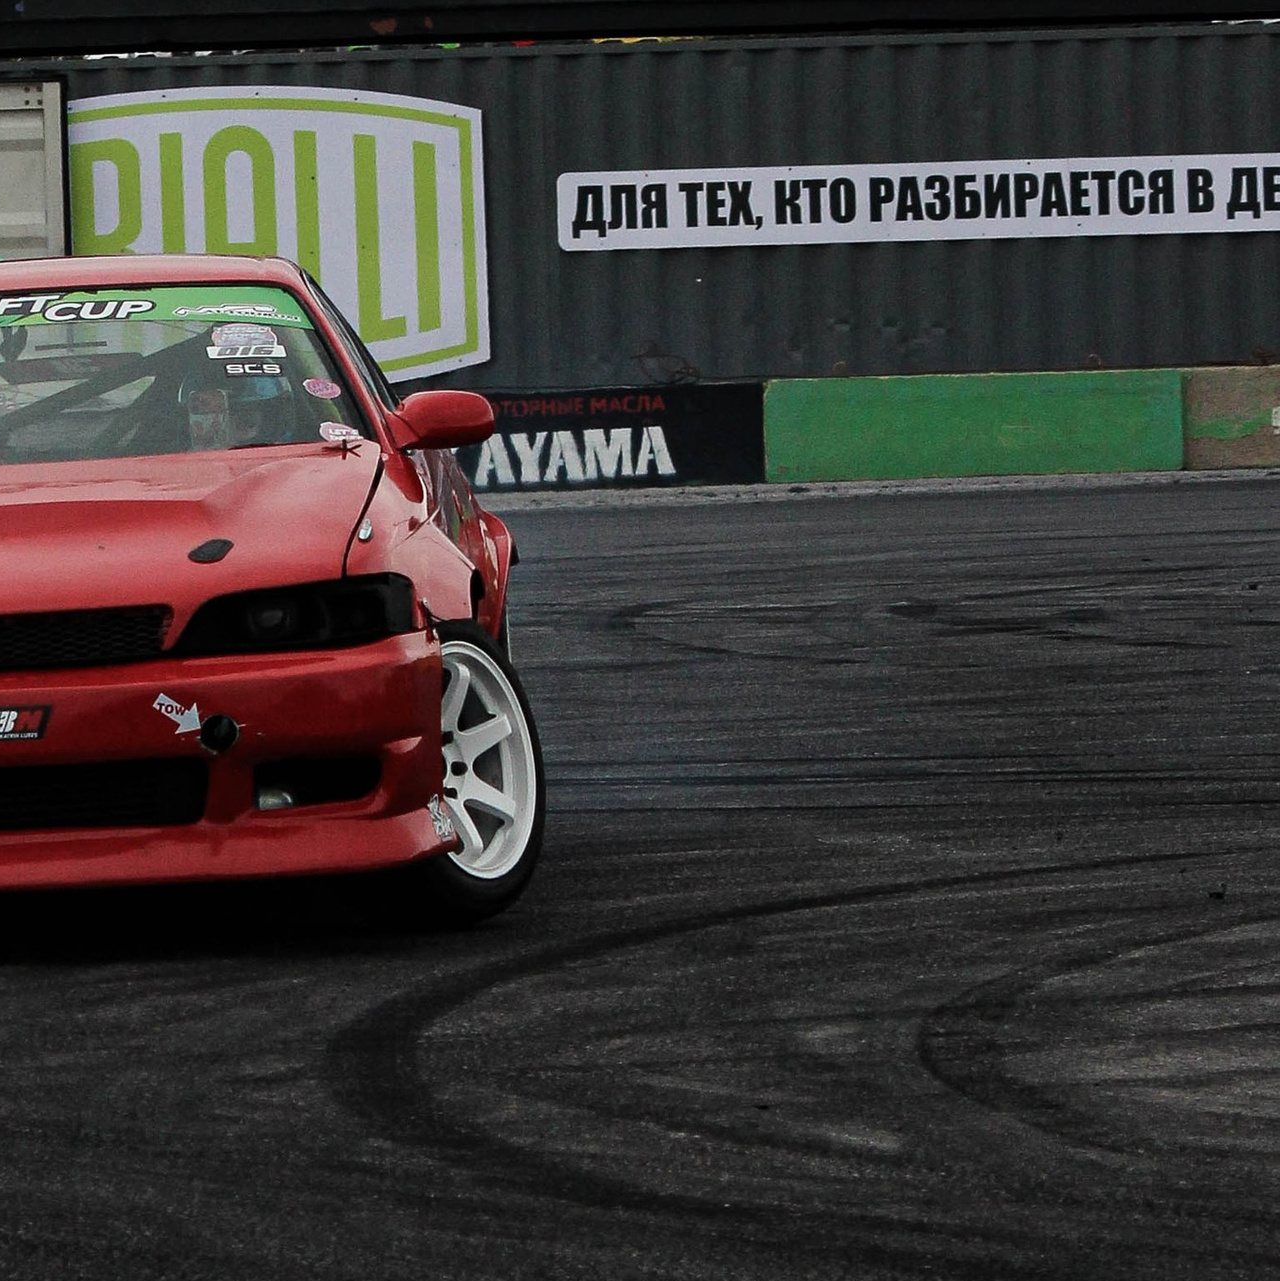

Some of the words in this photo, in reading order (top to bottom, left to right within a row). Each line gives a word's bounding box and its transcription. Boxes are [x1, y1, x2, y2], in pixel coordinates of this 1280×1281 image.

[572, 183, 668, 239] ДЛЯ
[678, 180, 764, 230] ТЕХ,
[774, 177, 857, 225] КТО
[869, 168, 1175, 222] РАЗБИРАЕТСЯ
[1186, 168, 1215, 213] В
[44, 300, 153, 322] CUP
[225, 363, 281, 374] SCS
[491, 396, 584, 418] ТОРНЫЕ
[473, 425, 677, 487] AYAMA
[156, 702, 186, 716] TOW
